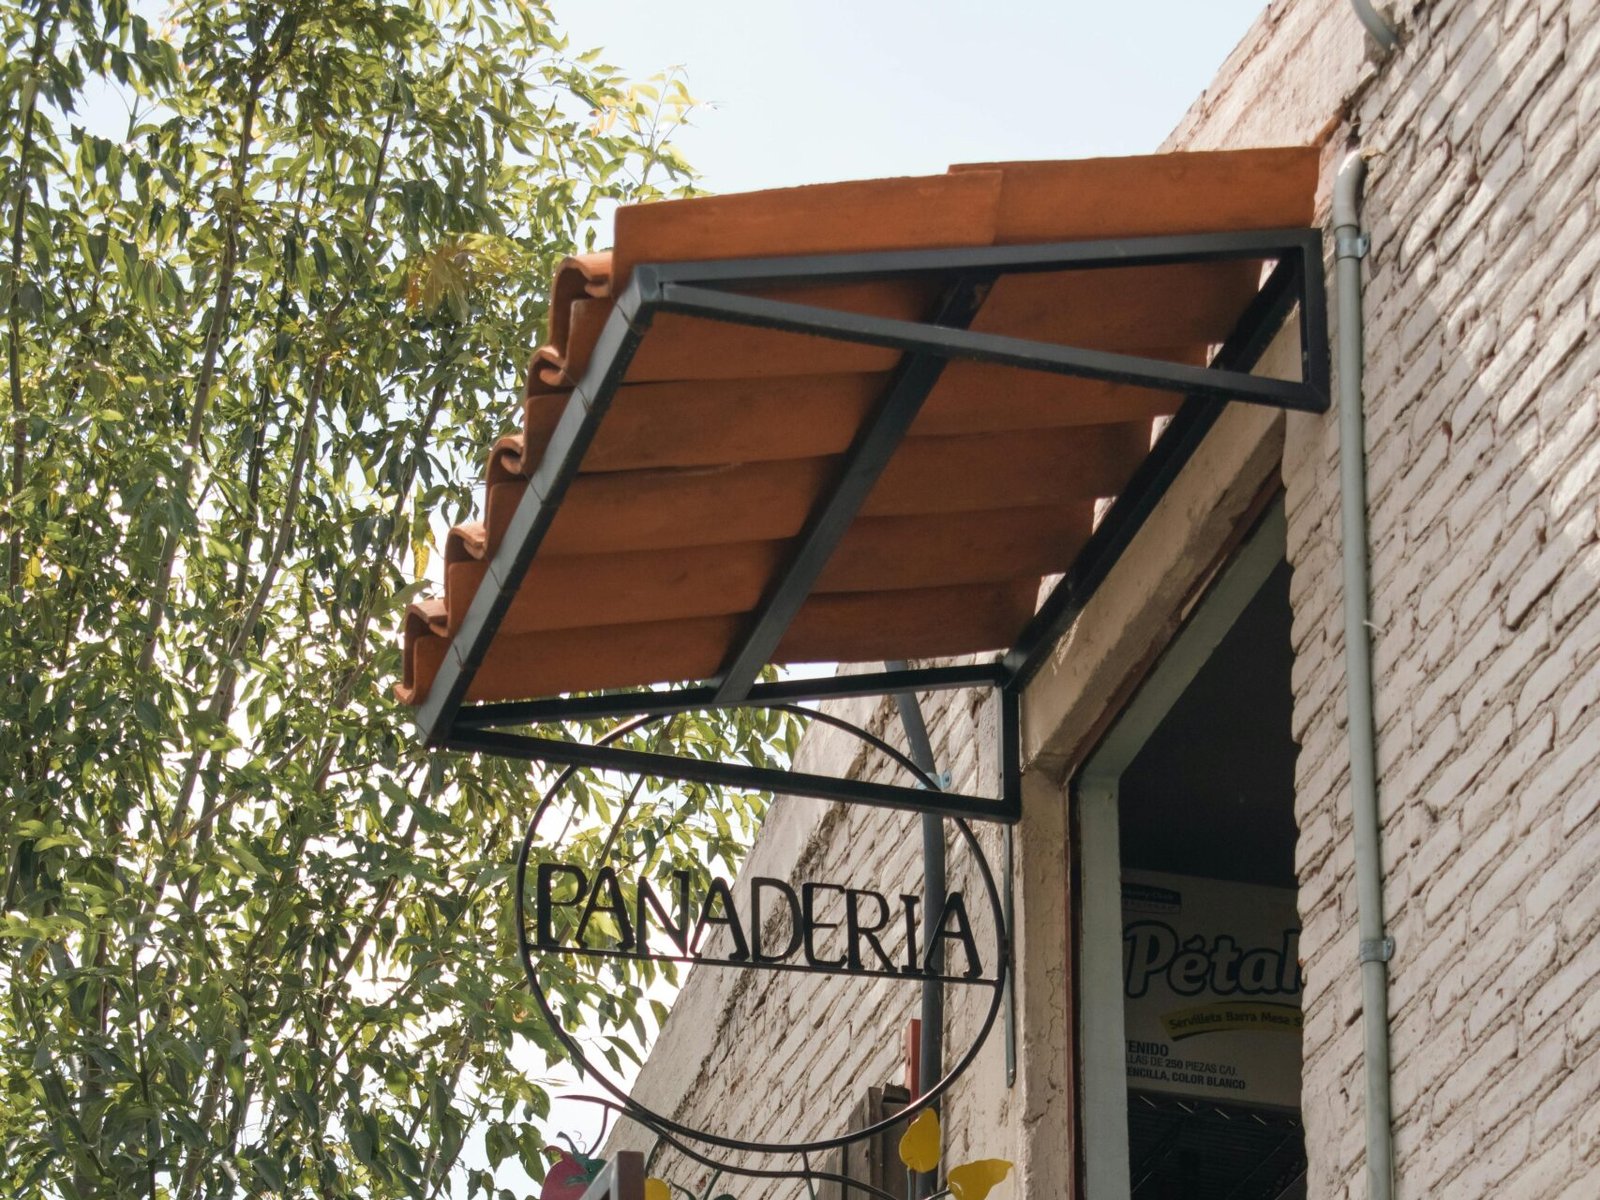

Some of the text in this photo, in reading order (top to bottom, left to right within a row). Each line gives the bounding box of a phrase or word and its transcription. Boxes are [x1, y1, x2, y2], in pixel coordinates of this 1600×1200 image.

[537, 863, 982, 978] PANADERIA
[1169, 1013, 1222, 1029] Servilleta
[1226, 1011, 1257, 1022] Barra
[1126, 1040, 1169, 1057] ENIDO
[1150, 1057, 1163, 1068] DE
[1165, 1058, 1183, 1070] 250
[1186, 1061, 1217, 1074] PIEZAS
[1126, 1066, 1246, 1090] ENCILLA, COLOR BLANCO
